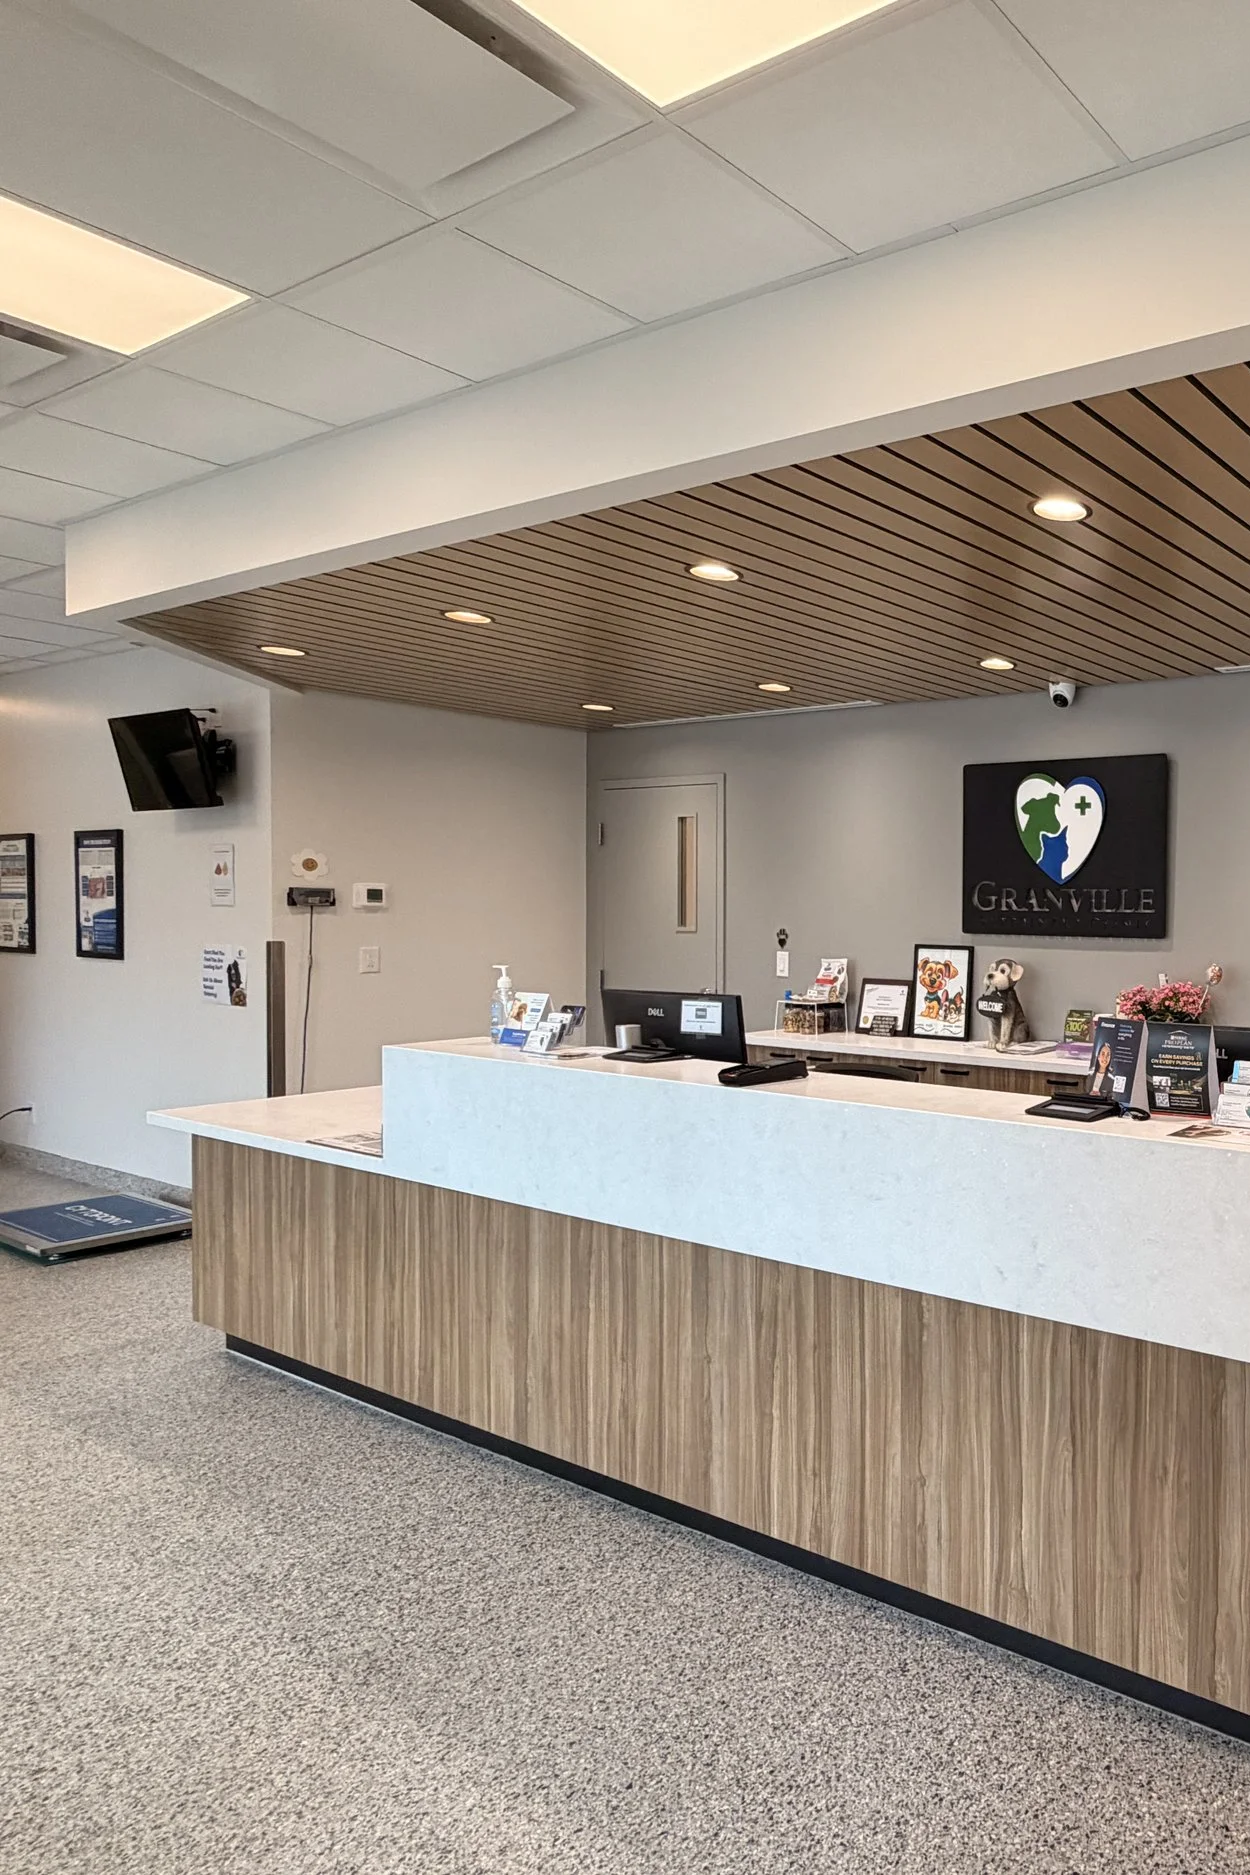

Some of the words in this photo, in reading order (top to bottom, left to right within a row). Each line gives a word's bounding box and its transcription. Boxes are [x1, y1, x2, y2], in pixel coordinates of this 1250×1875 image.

[972, 880, 1156, 913] GRANVILLE
[648, 1007, 664, 1016] DELL
[978, 1000, 1003, 1013] WELCOME
[1216, 1048, 1228, 1059] LL
